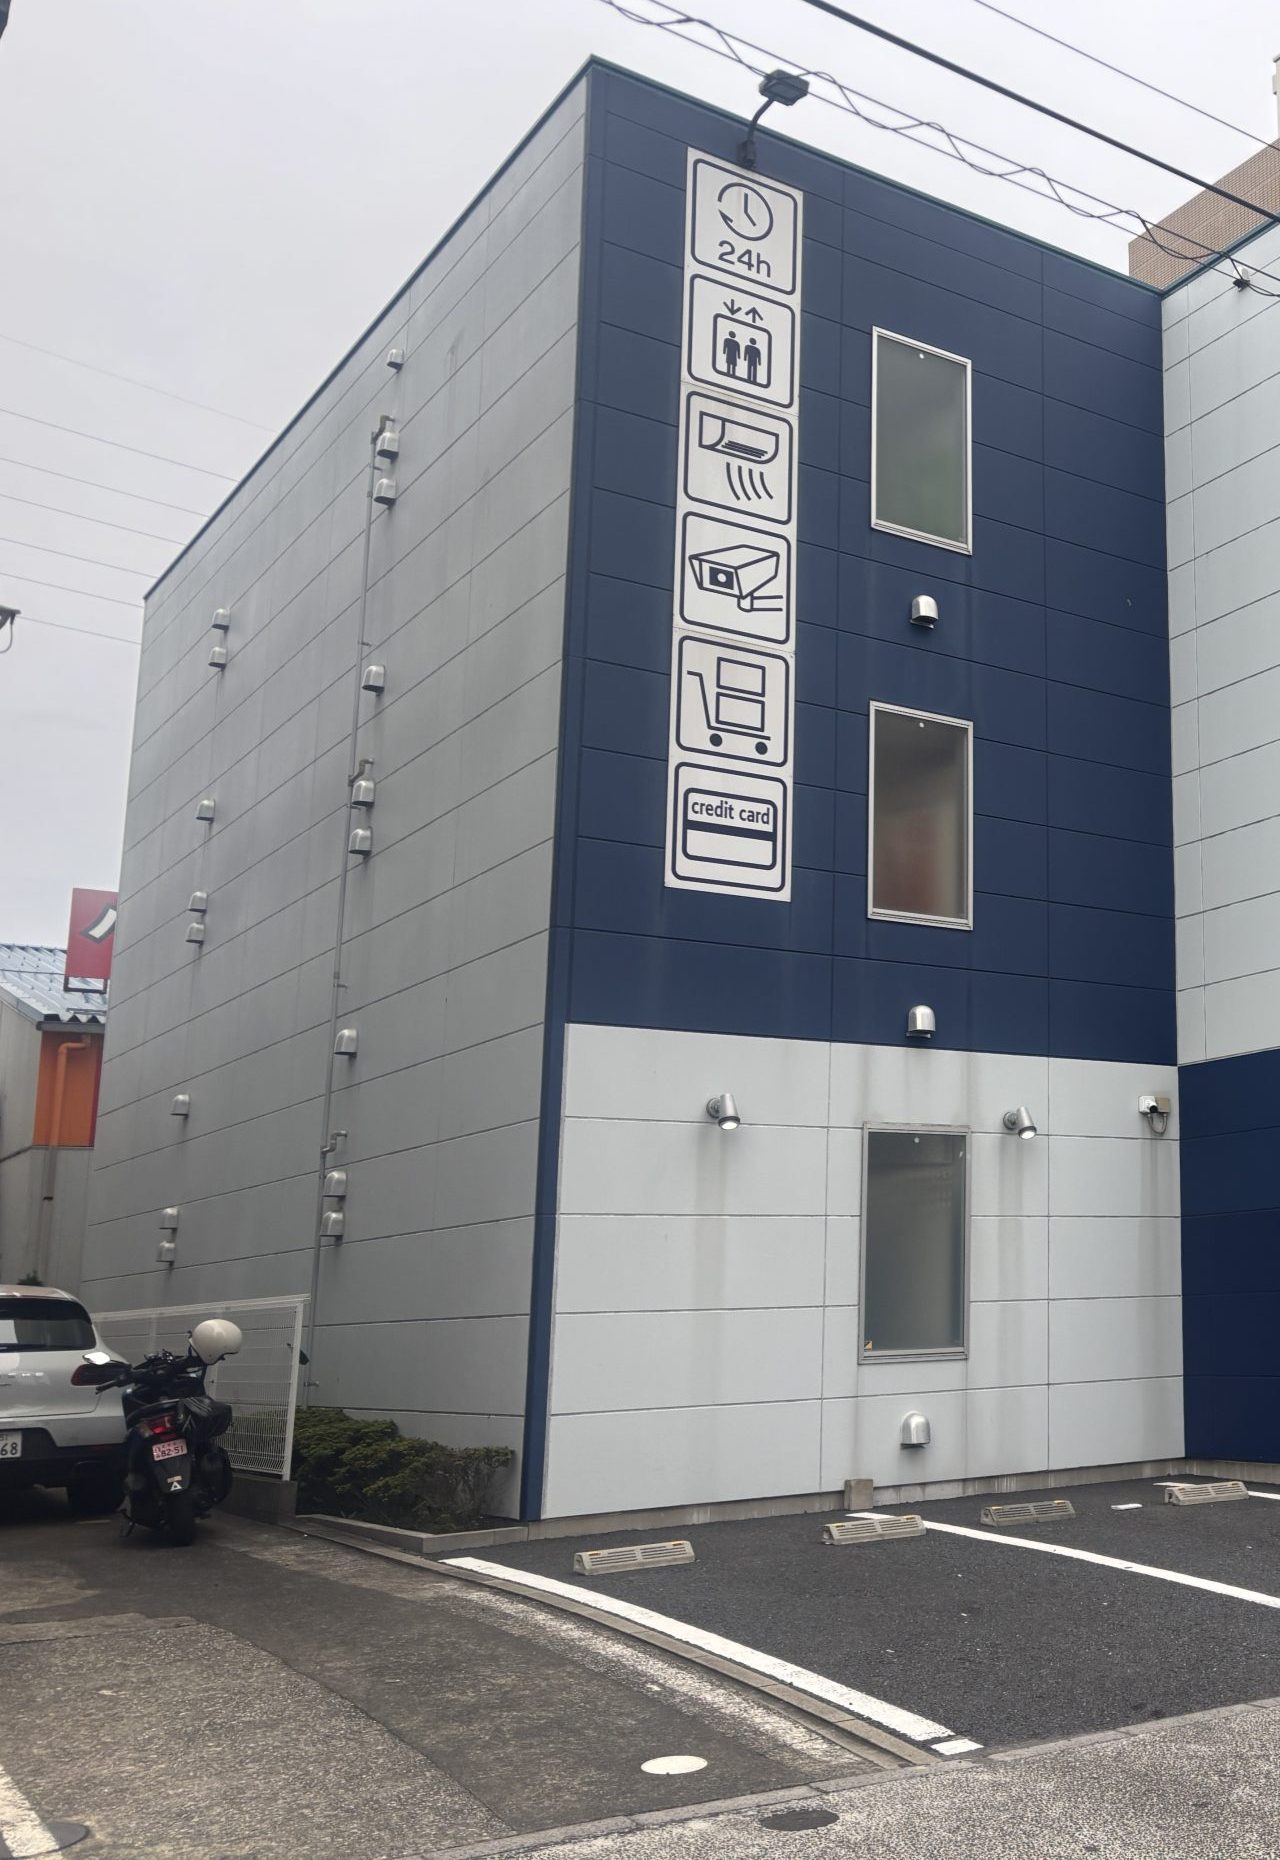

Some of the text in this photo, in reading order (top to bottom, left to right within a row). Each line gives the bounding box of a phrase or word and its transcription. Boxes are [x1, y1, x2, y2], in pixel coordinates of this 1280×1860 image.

[718, 240, 771, 278] 24h
[691, 799, 770, 825] credit card
